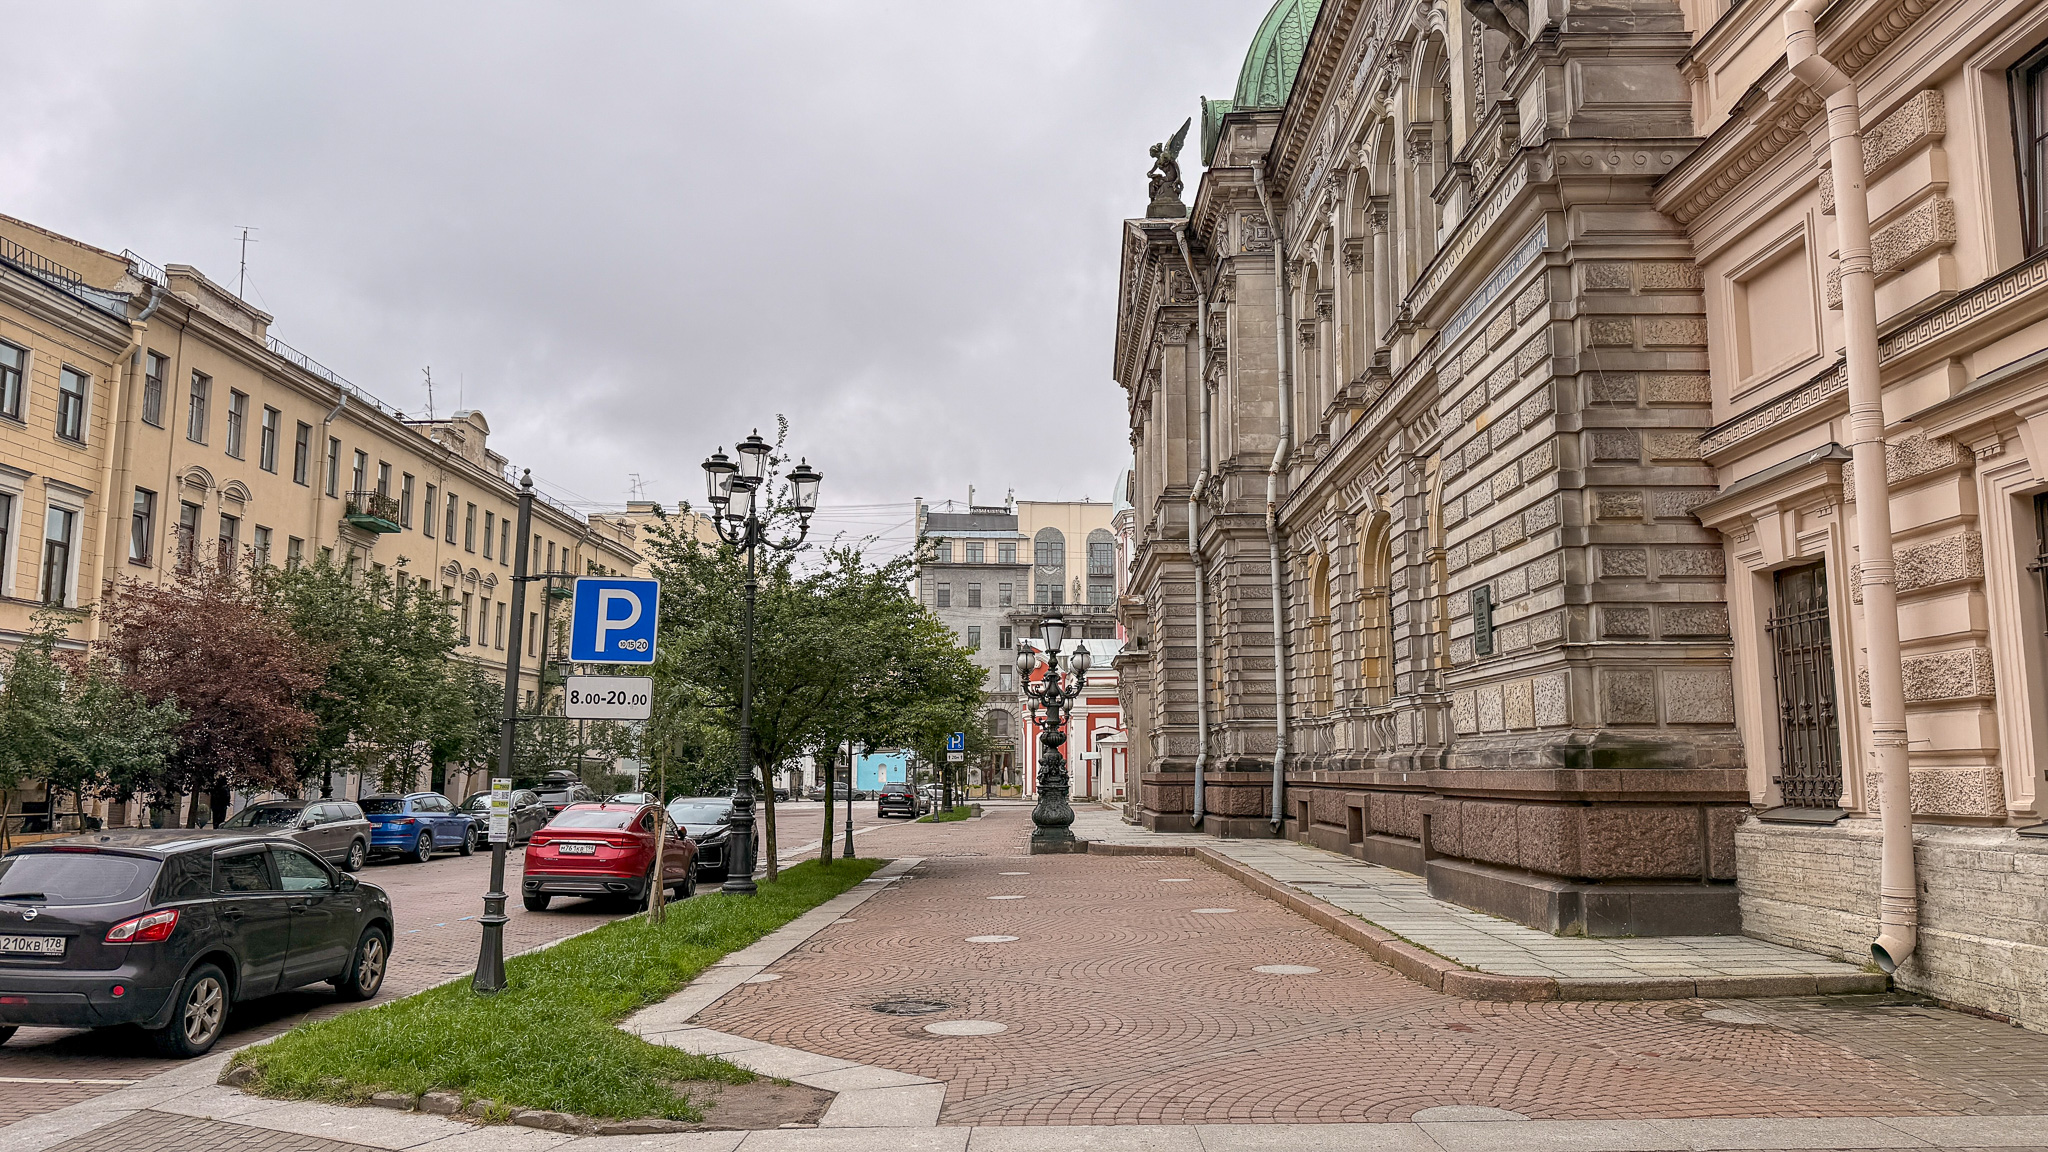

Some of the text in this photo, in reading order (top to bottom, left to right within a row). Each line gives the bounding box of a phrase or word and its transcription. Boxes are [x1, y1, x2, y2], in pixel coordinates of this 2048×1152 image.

[594, 588, 642, 652] P
[637, 641, 648, 649] 20
[570, 690, 647, 706] 8.00-20.00
[44, 938, 62, 948] 178
